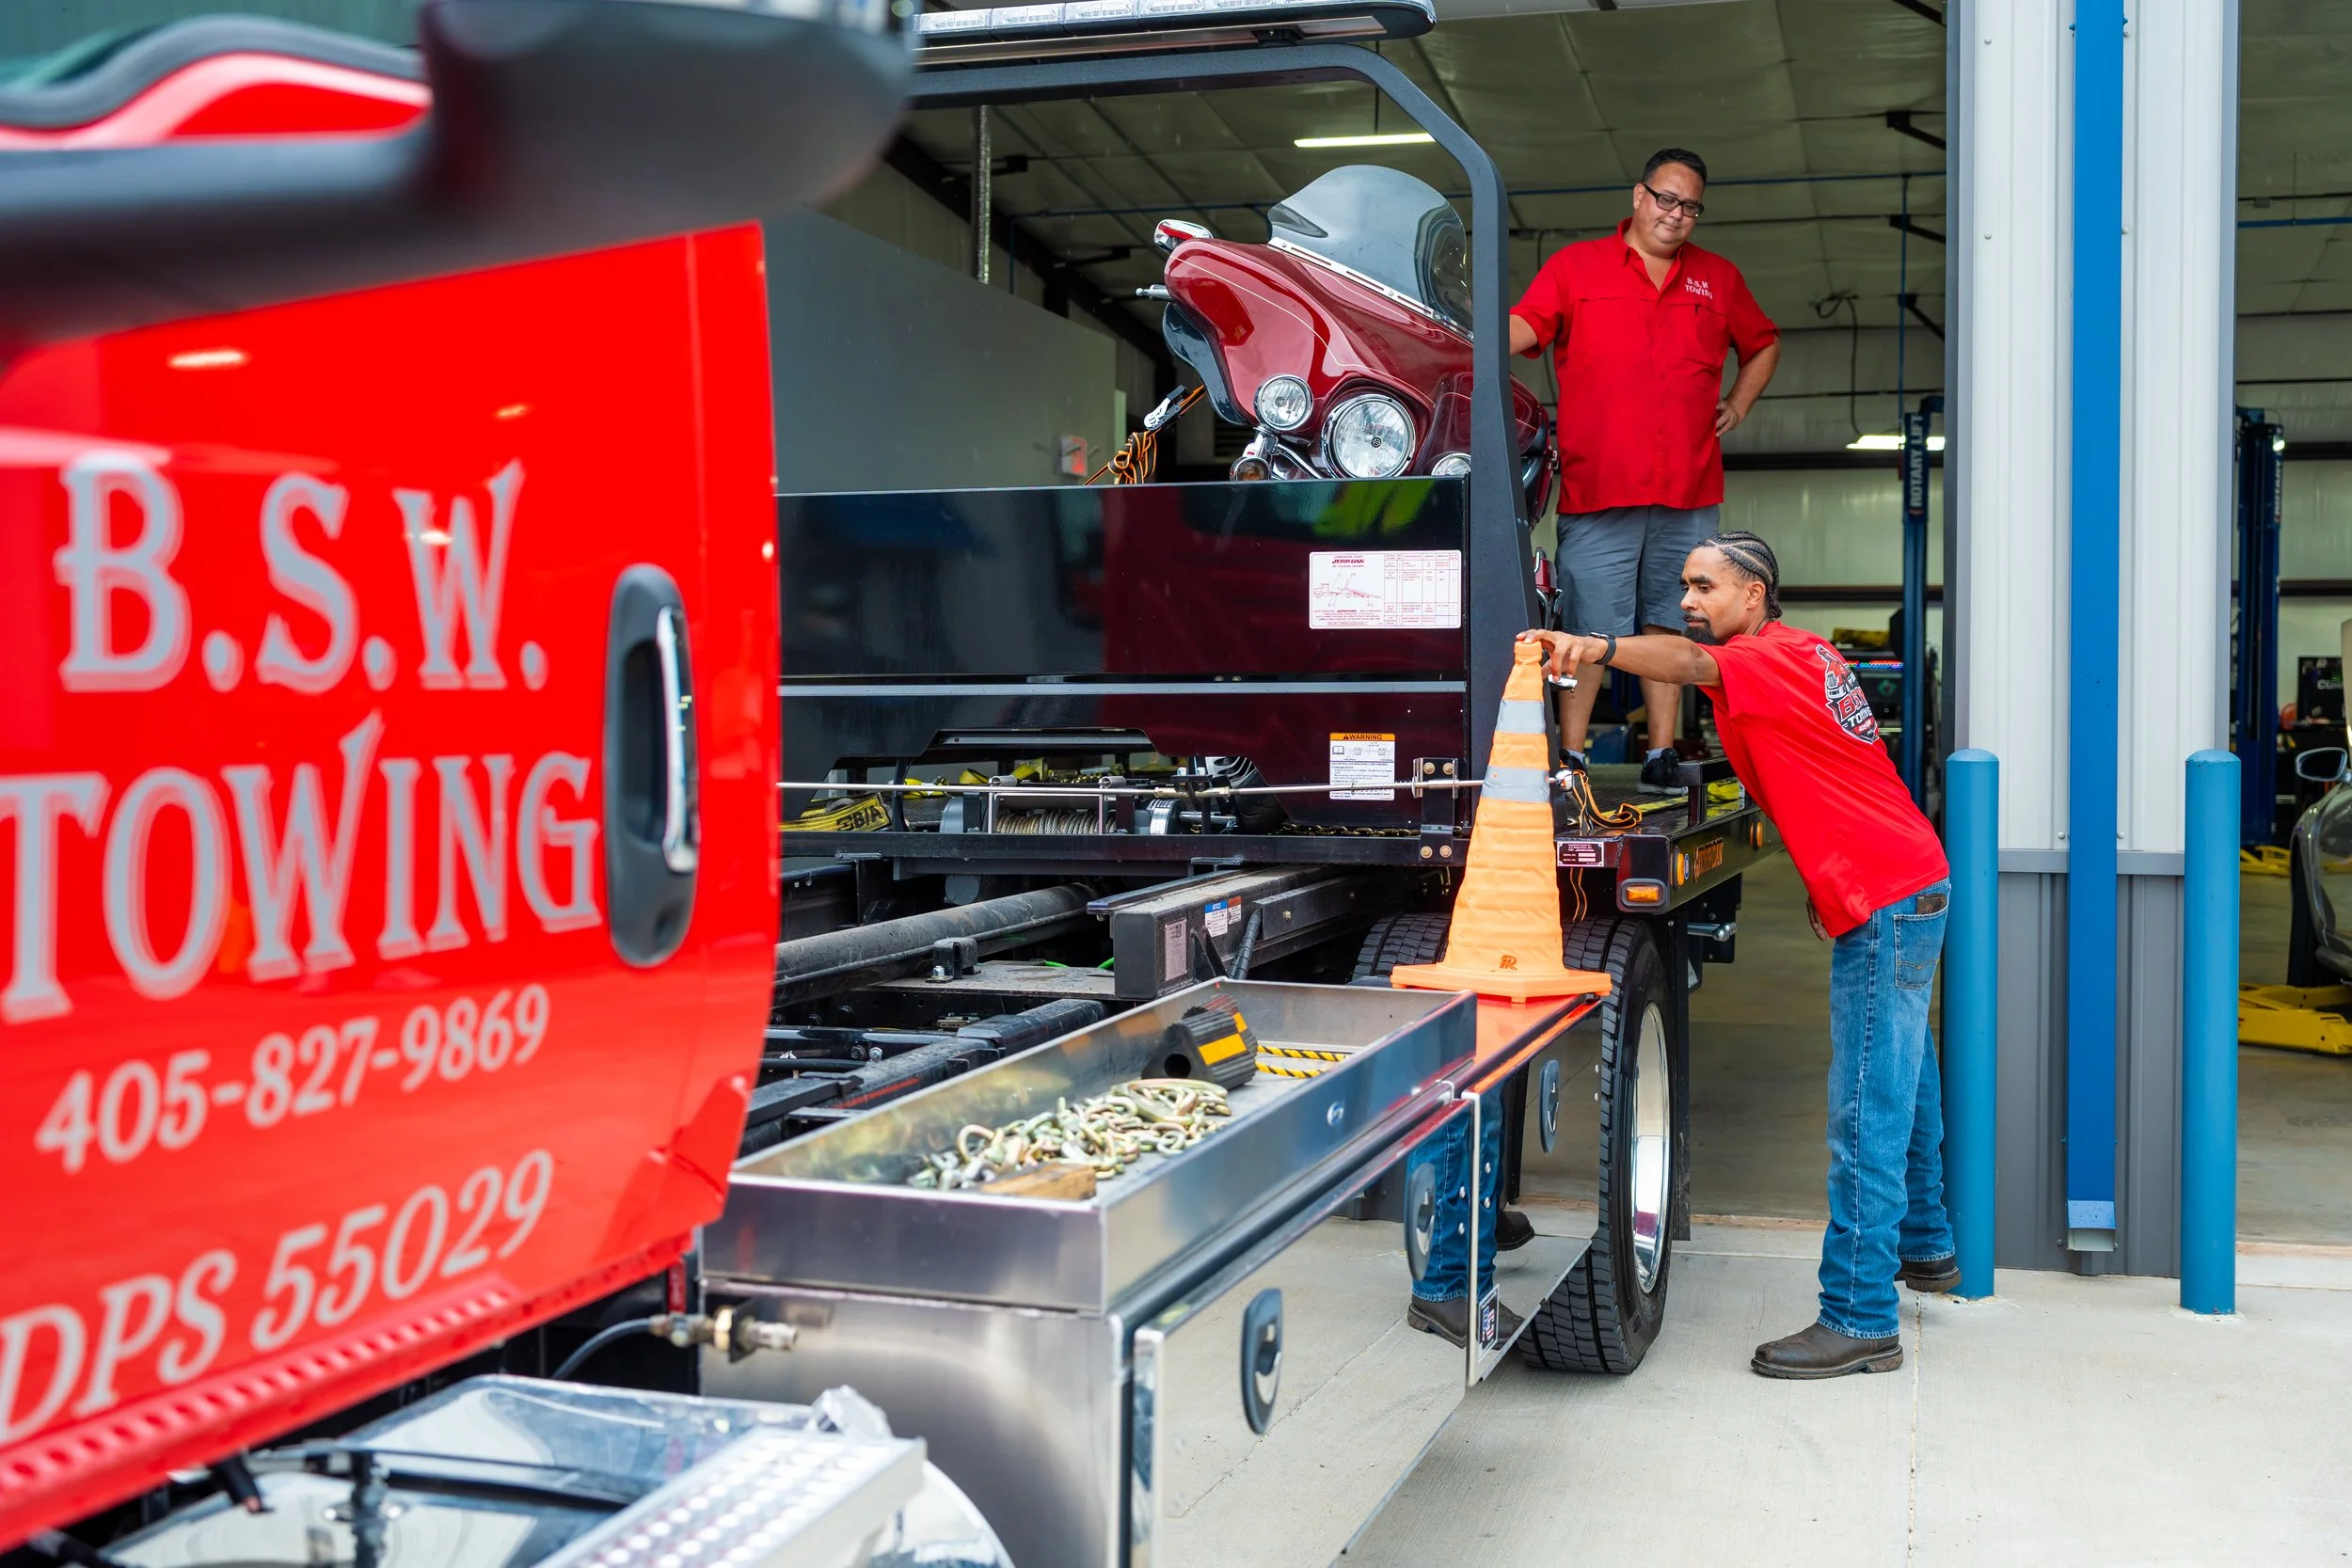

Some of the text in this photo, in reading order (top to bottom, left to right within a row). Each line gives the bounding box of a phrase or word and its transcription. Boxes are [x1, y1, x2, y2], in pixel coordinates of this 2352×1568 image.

[53, 451, 549, 694] B.S.W.
[1911, 448, 1923, 507] ROTARY
[0, 707, 603, 1022] TOWING
[35, 984, 551, 1175] 405-827-9869
[0, 1149, 555, 1445] DPS 55029
